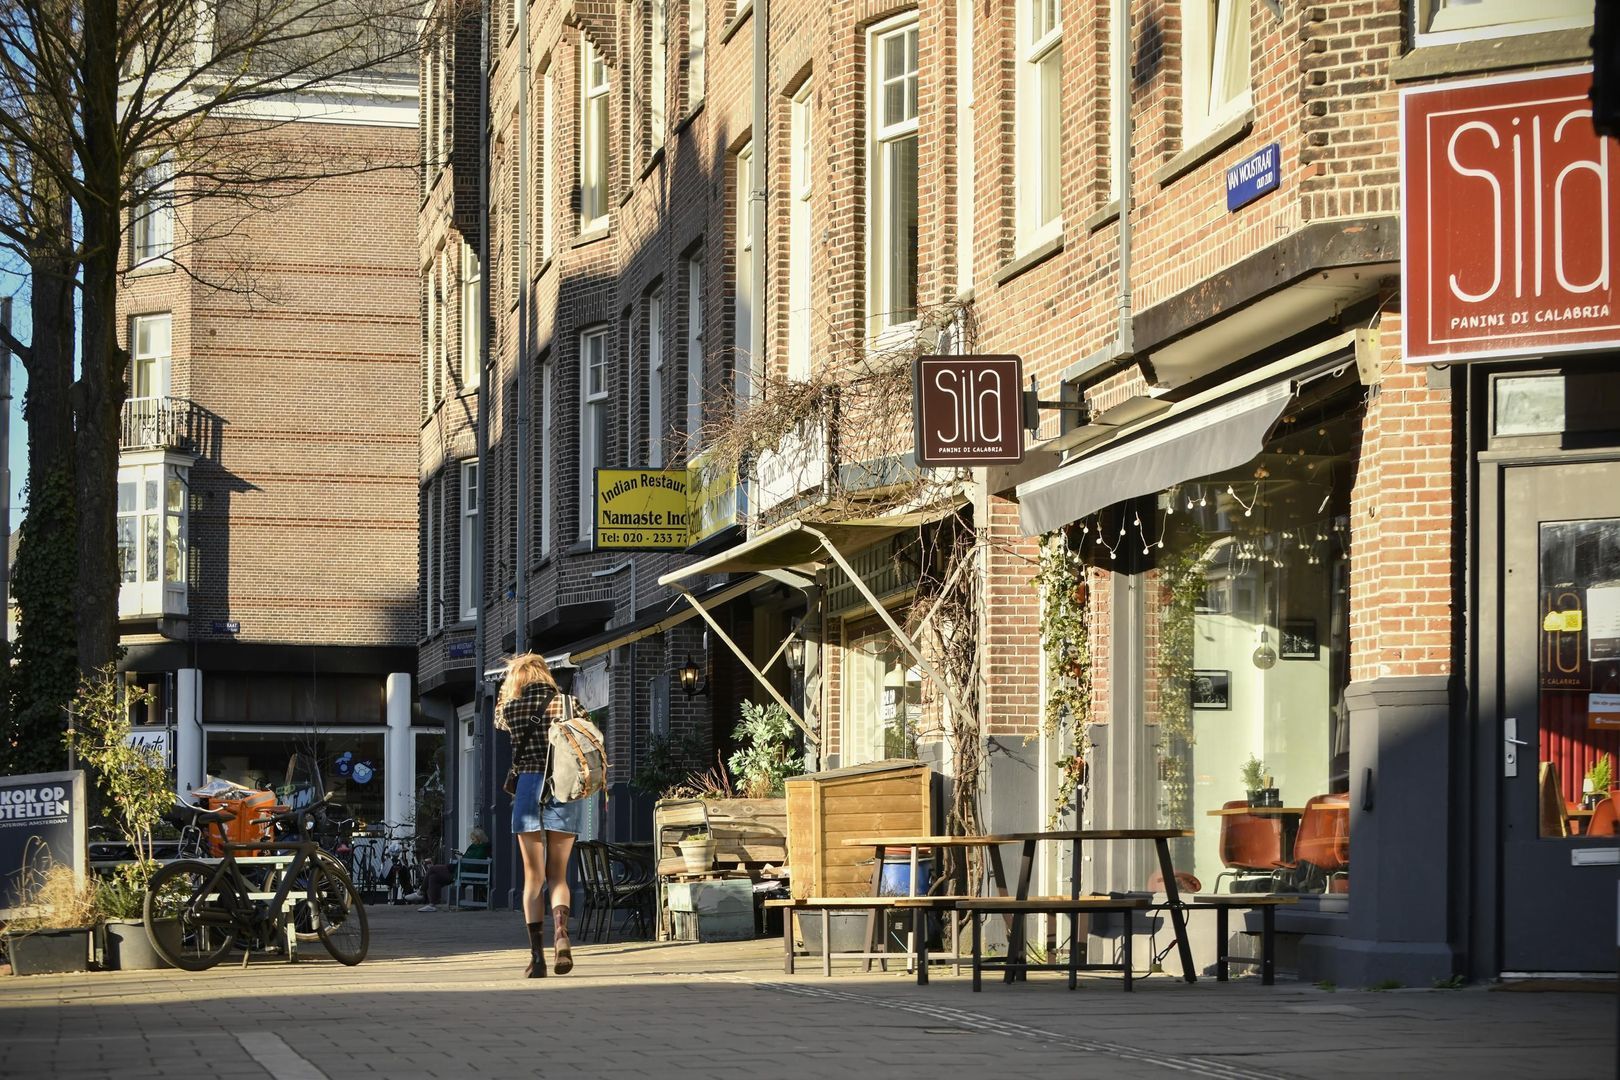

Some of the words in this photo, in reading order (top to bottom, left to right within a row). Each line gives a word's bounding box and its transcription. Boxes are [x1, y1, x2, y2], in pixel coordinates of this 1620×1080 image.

[1227, 169, 1239, 190] VAN
[1239, 149, 1272, 184] WOUSTRAAT
[1447, 109, 1610, 302] Sila
[1451, 313, 1505, 329] PANINI
[1511, 311, 1528, 324] DI
[1535, 304, 1610, 323] CALABRIA
[936, 369, 1002, 442] Sila
[601, 478, 638, 503] Indian
[641, 473, 687, 496] Restaur
[602, 510, 662, 525] Namaste
[601, 533, 620, 543] Tel:
[623, 533, 643, 543] 020
[654, 533, 673, 543] 233
[1, 789, 37, 805] KOK
[40, 787, 65, 801] OP
[29, 818, 68, 826] AMSTERDAM
